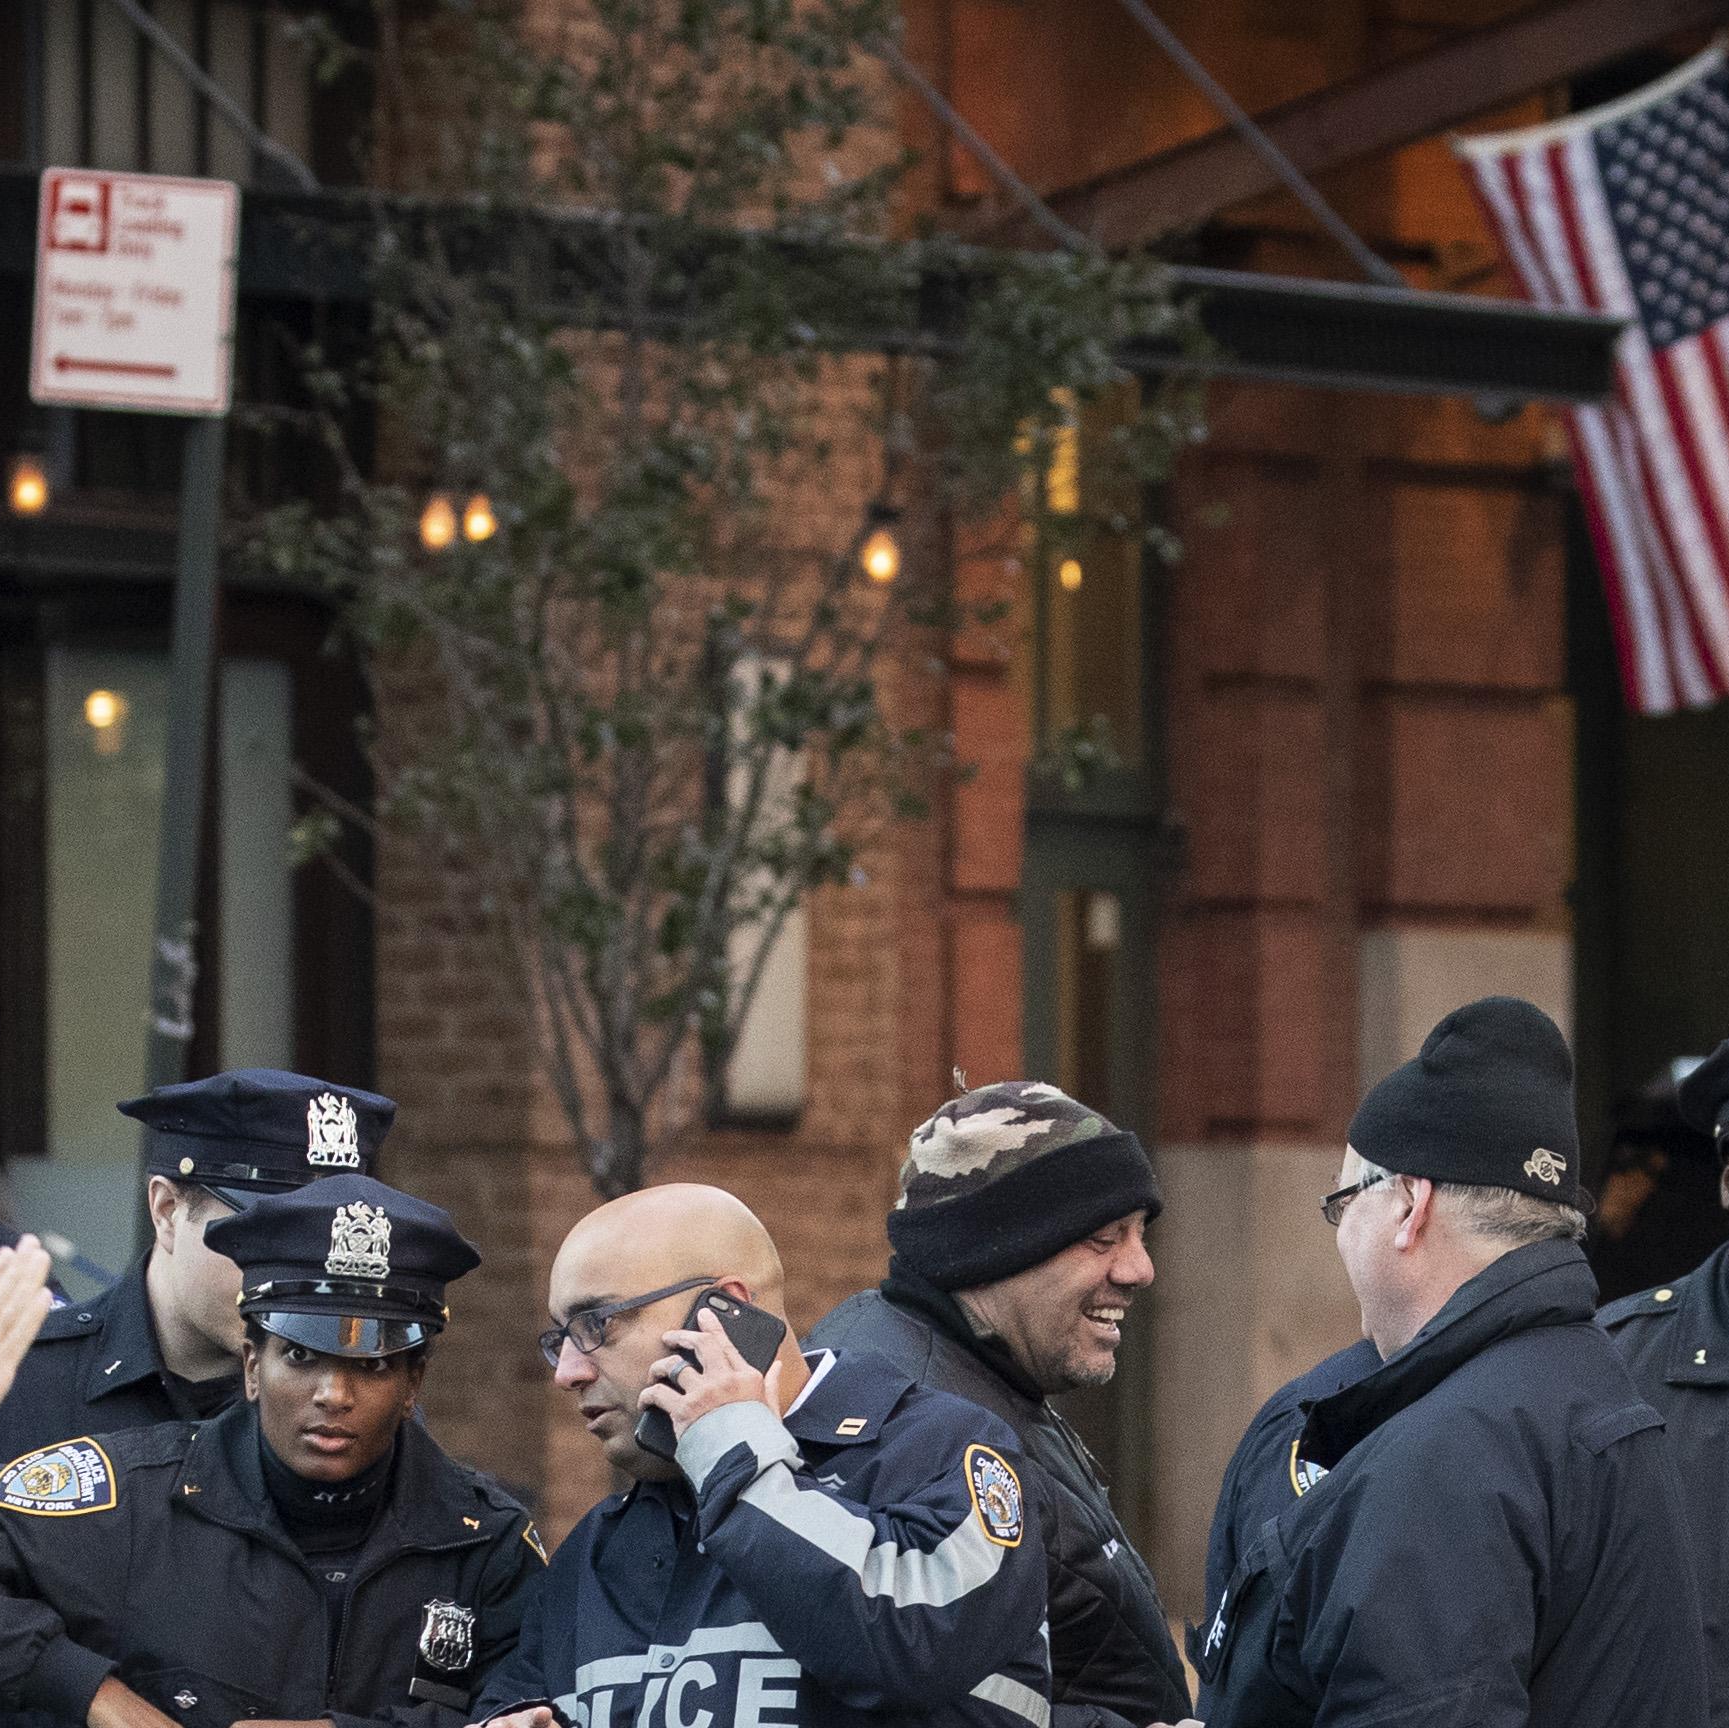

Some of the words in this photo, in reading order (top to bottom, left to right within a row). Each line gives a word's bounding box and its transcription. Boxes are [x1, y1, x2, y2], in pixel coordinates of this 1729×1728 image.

[17, 1453, 45, 1471] CITY
[82, 1449, 106, 1485] POLICE
[2, 1469, 18, 1484] OF
[59, 1446, 96, 1503] DEPARTMENT
[973, 1471, 986, 1498] CITY
[4, 1495, 35, 1509] NEW
[35, 1500, 76, 1510] YORK
